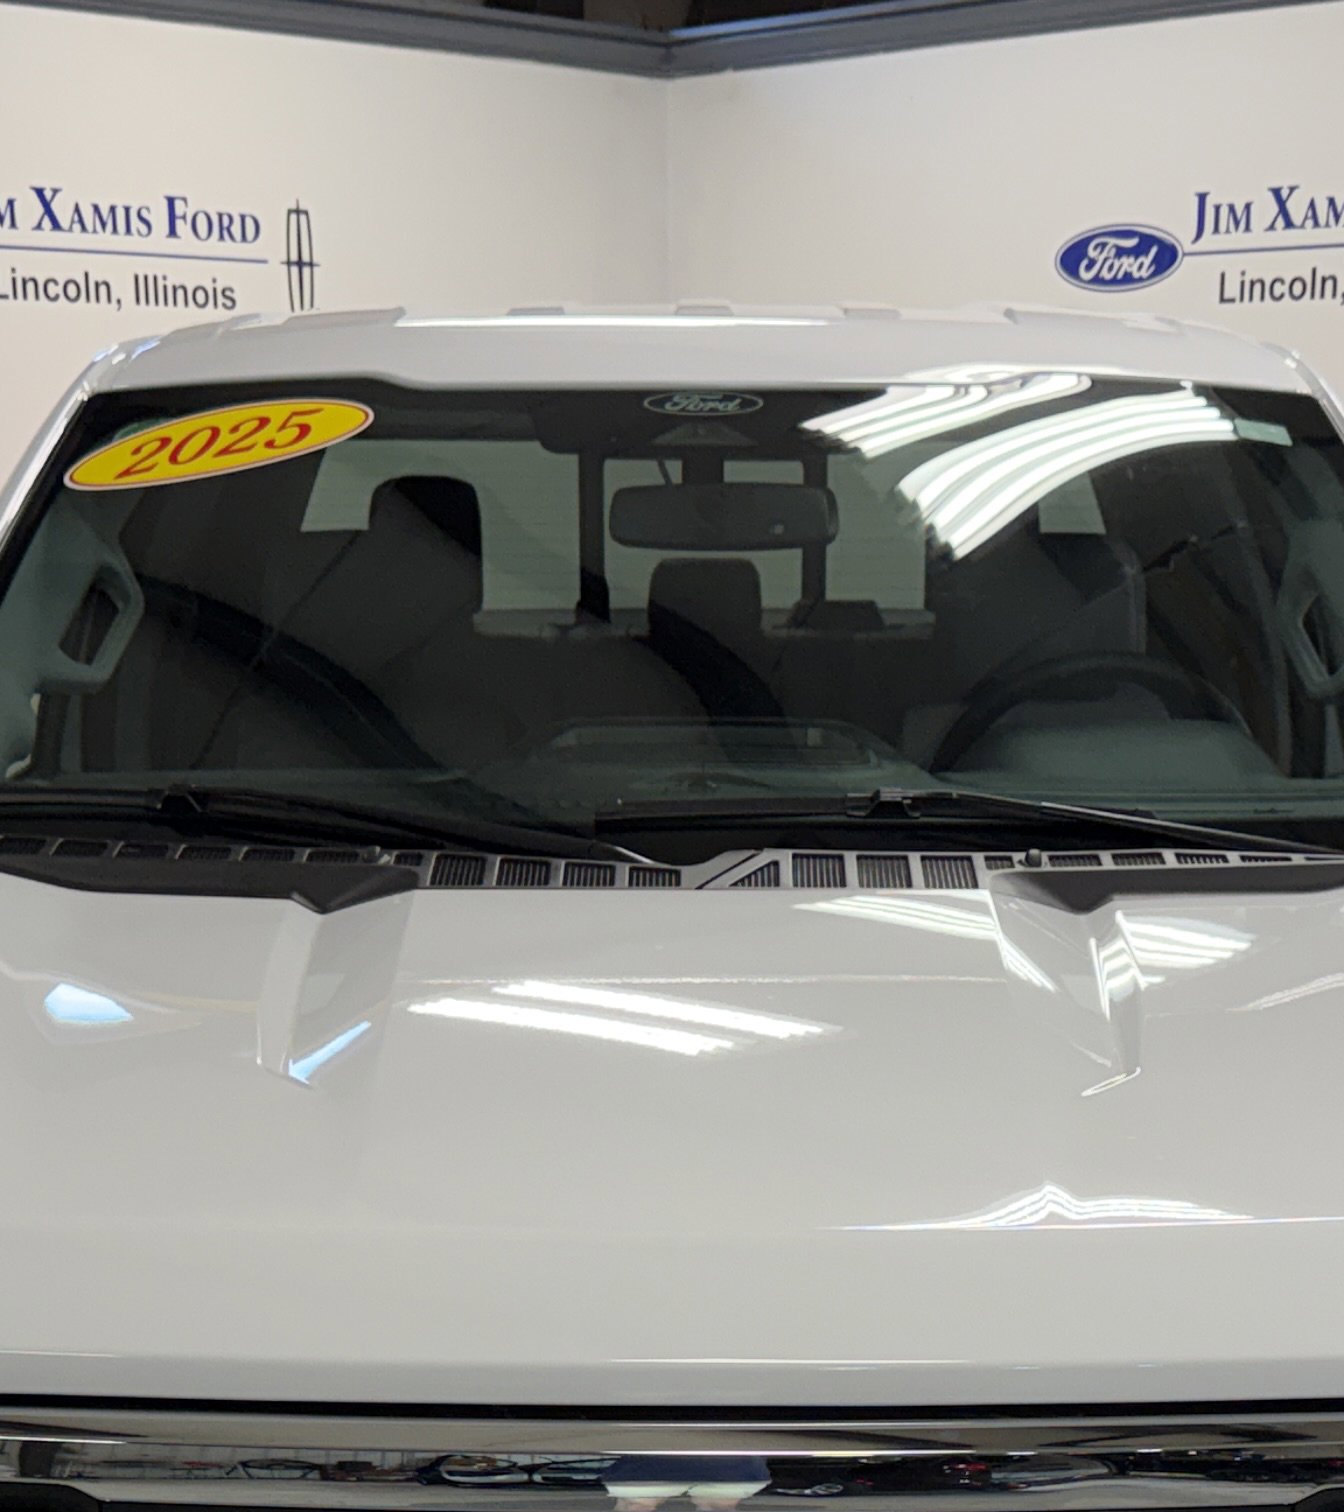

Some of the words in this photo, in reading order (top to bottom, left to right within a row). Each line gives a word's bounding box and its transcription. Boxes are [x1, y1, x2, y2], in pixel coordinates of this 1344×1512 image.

[29, 186, 153, 239] XAMIS
[162, 195, 262, 244] FORD
[1191, 191, 1254, 244] JIM
[1077, 236, 1157, 282] Ford
[133, 273, 238, 311] Illinois
[115, 409, 325, 478] 2025
